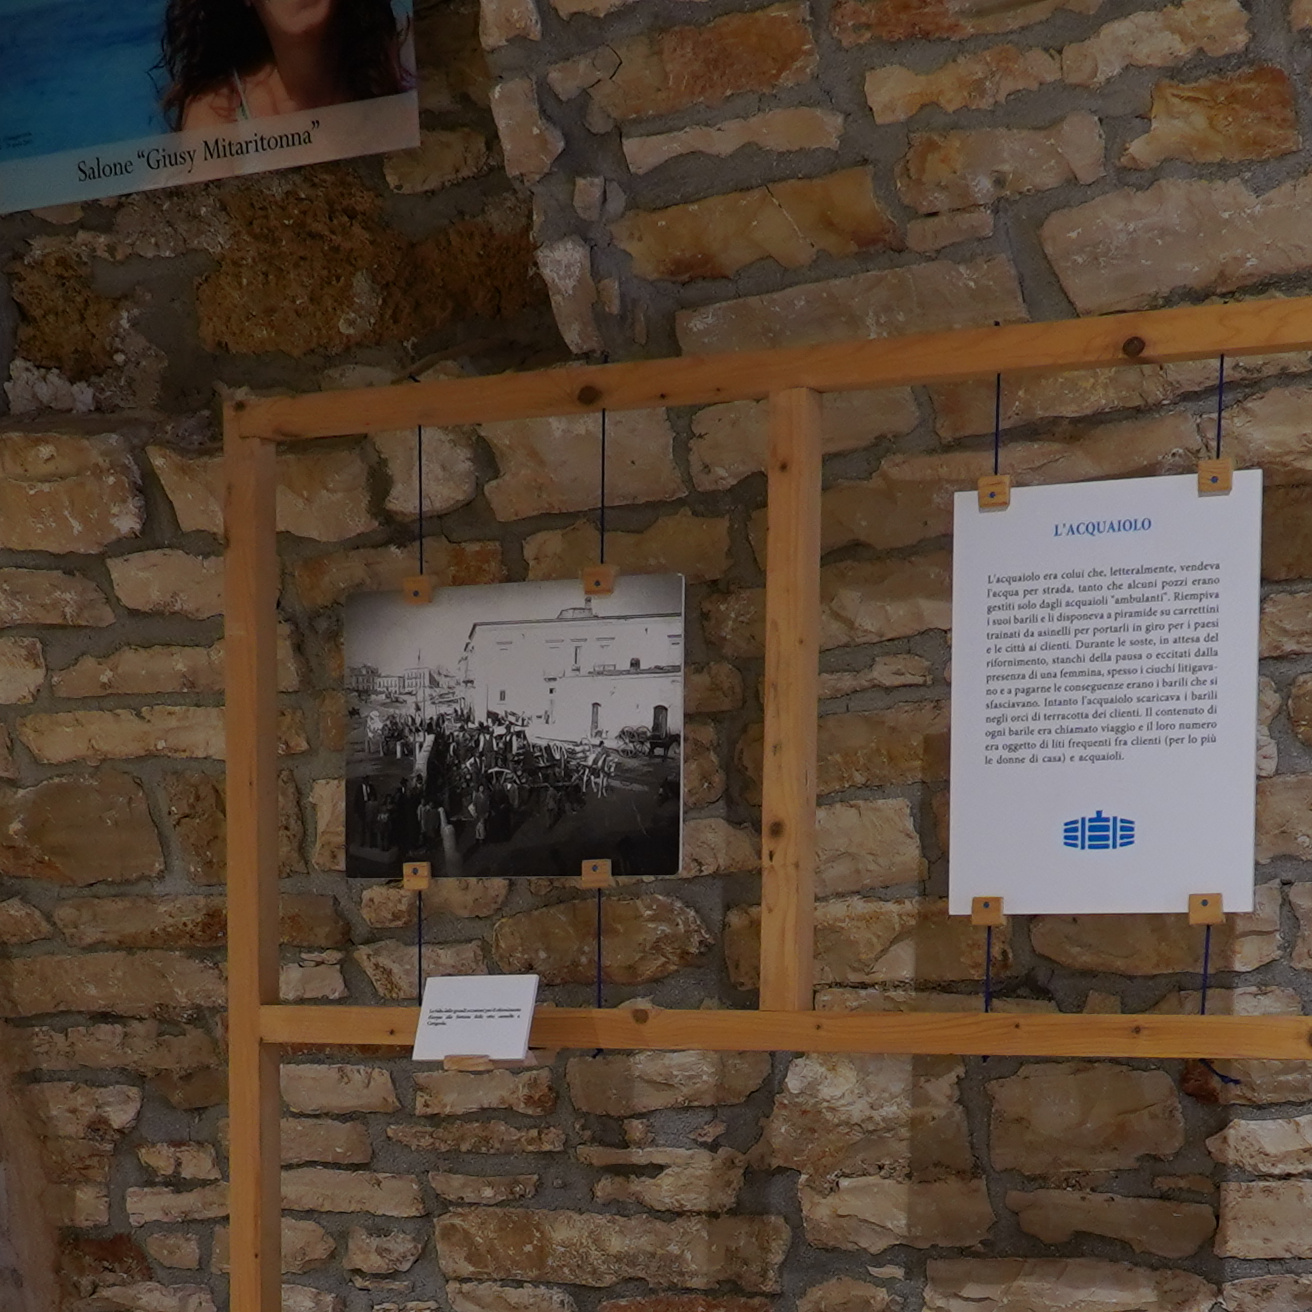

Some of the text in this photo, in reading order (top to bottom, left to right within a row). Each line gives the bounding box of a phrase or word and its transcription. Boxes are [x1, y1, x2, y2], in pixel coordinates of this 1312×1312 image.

[76, 156, 134, 183] Salone
[1054, 518, 1152, 537] L'ACQUAIOLO
[1042, 572, 1057, 580] era
[1060, 568, 1084, 579] colui
[1179, 559, 1220, 572] vendeva
[1022, 588, 1038, 598] per
[1078, 583, 1102, 592] tanto
[1106, 580, 1123, 590] che
[1126, 578, 1157, 589] alcuni
[1161, 577, 1187, 590] pozzi
[1191, 577, 1220, 585] erano
[986, 602, 1014, 615] gestiti
[1017, 599, 1036, 610] solo
[1038, 598, 1062, 611] dagli
[1064, 595, 1108, 609] acquaioli
[1173, 589, 1219, 603] Riempiva
[992, 616, 1011, 625] suoi
[1013, 613, 1038, 624] barili
[1047, 612, 1054, 622] li
[1056, 610, 1104, 624] disponeva
[1114, 606, 1157, 621] piramide
[1159, 608, 1170, 616] su
[1172, 604, 1219, 615] carrettini
[986, 630, 1020, 639] trainati
[1023, 628, 1034, 637] da
[1037, 625, 1070, 636] asinelli
[1073, 627, 1090, 637] per
[1092, 622, 1129, 636] portarli
[1132, 623, 1142, 632] in
[1144, 621, 1165, 634] giro
[1167, 622, 1184, 633] per
[1193, 618, 1218, 631] paesi
[994, 643, 1002, 653] le
[1004, 642, 1025, 652] città
[1028, 642, 1036, 651] ai
[1075, 638, 1114, 648] Durante
[1117, 636, 1126, 646] le
[1159, 635, 1169, 644] in
[1172, 635, 1200, 644] attesa
[1203, 632, 1218, 642] del
[1051, 653, 1085, 664] stanchi
[1088, 652, 1112, 662] della
[1115, 653, 1142, 664] pausa
[1155, 648, 1190, 659] eccitati
[1193, 646, 1218, 657] dalla
[985, 673, 1026, 684] presenza
[1028, 669, 1037, 679] di
[1106, 667, 1138, 678] spesso
[1145, 663, 1175, 674] ciuchi
[1014, 686, 1051, 696] pagarne
[1053, 682, 1062, 692] le
[1063, 682, 1124, 694] conseguenze
[1125, 681, 1154, 689] erano
[1161, 676, 1187, 687] barili
[1190, 676, 1207, 686] che
[1209, 676, 1217, 685] si
[1044, 696, 1078, 706] Intanto
[1136, 692, 1180, 702] scaricava
[1191, 689, 1217, 700] barili
[985, 713, 1008, 726] negli
[1010, 713, 1028, 722] orci
[1031, 711, 1040, 721] di
[1043, 711, 1089, 720] terracotta
[1091, 708, 1106, 718] dei
[1145, 706, 1152, 716] Il
[1154, 706, 1204, 716] contenuto
[1206, 704, 1217, 714] di
[984, 728, 1005, 739] ogni
[1008, 725, 1034, 736] barile
[1054, 723, 1098, 734] chiamato
[1100, 722, 1135, 735] viaggio
[1146, 721, 1153, 730] il
[1155, 720, 1176, 730] loro
[1178, 721, 1217, 729] numero
[1001, 741, 1036, 752] oggetto
[1038, 738, 1048, 748] di
[1051, 738, 1064, 748] liti
[1067, 736, 1111, 750] frequenti
[1114, 736, 1128, 746] fra
[1130, 735, 1161, 745] clienti
[1164, 735, 1185, 747] (per
[1187, 734, 1197, 743] lo
[1200, 733, 1216, 746] più
[984, 755, 993, 764] le
[996, 754, 1025, 764] donne
[1028, 753, 1038, 763] di
[1041, 752, 1065, 763] casa)
